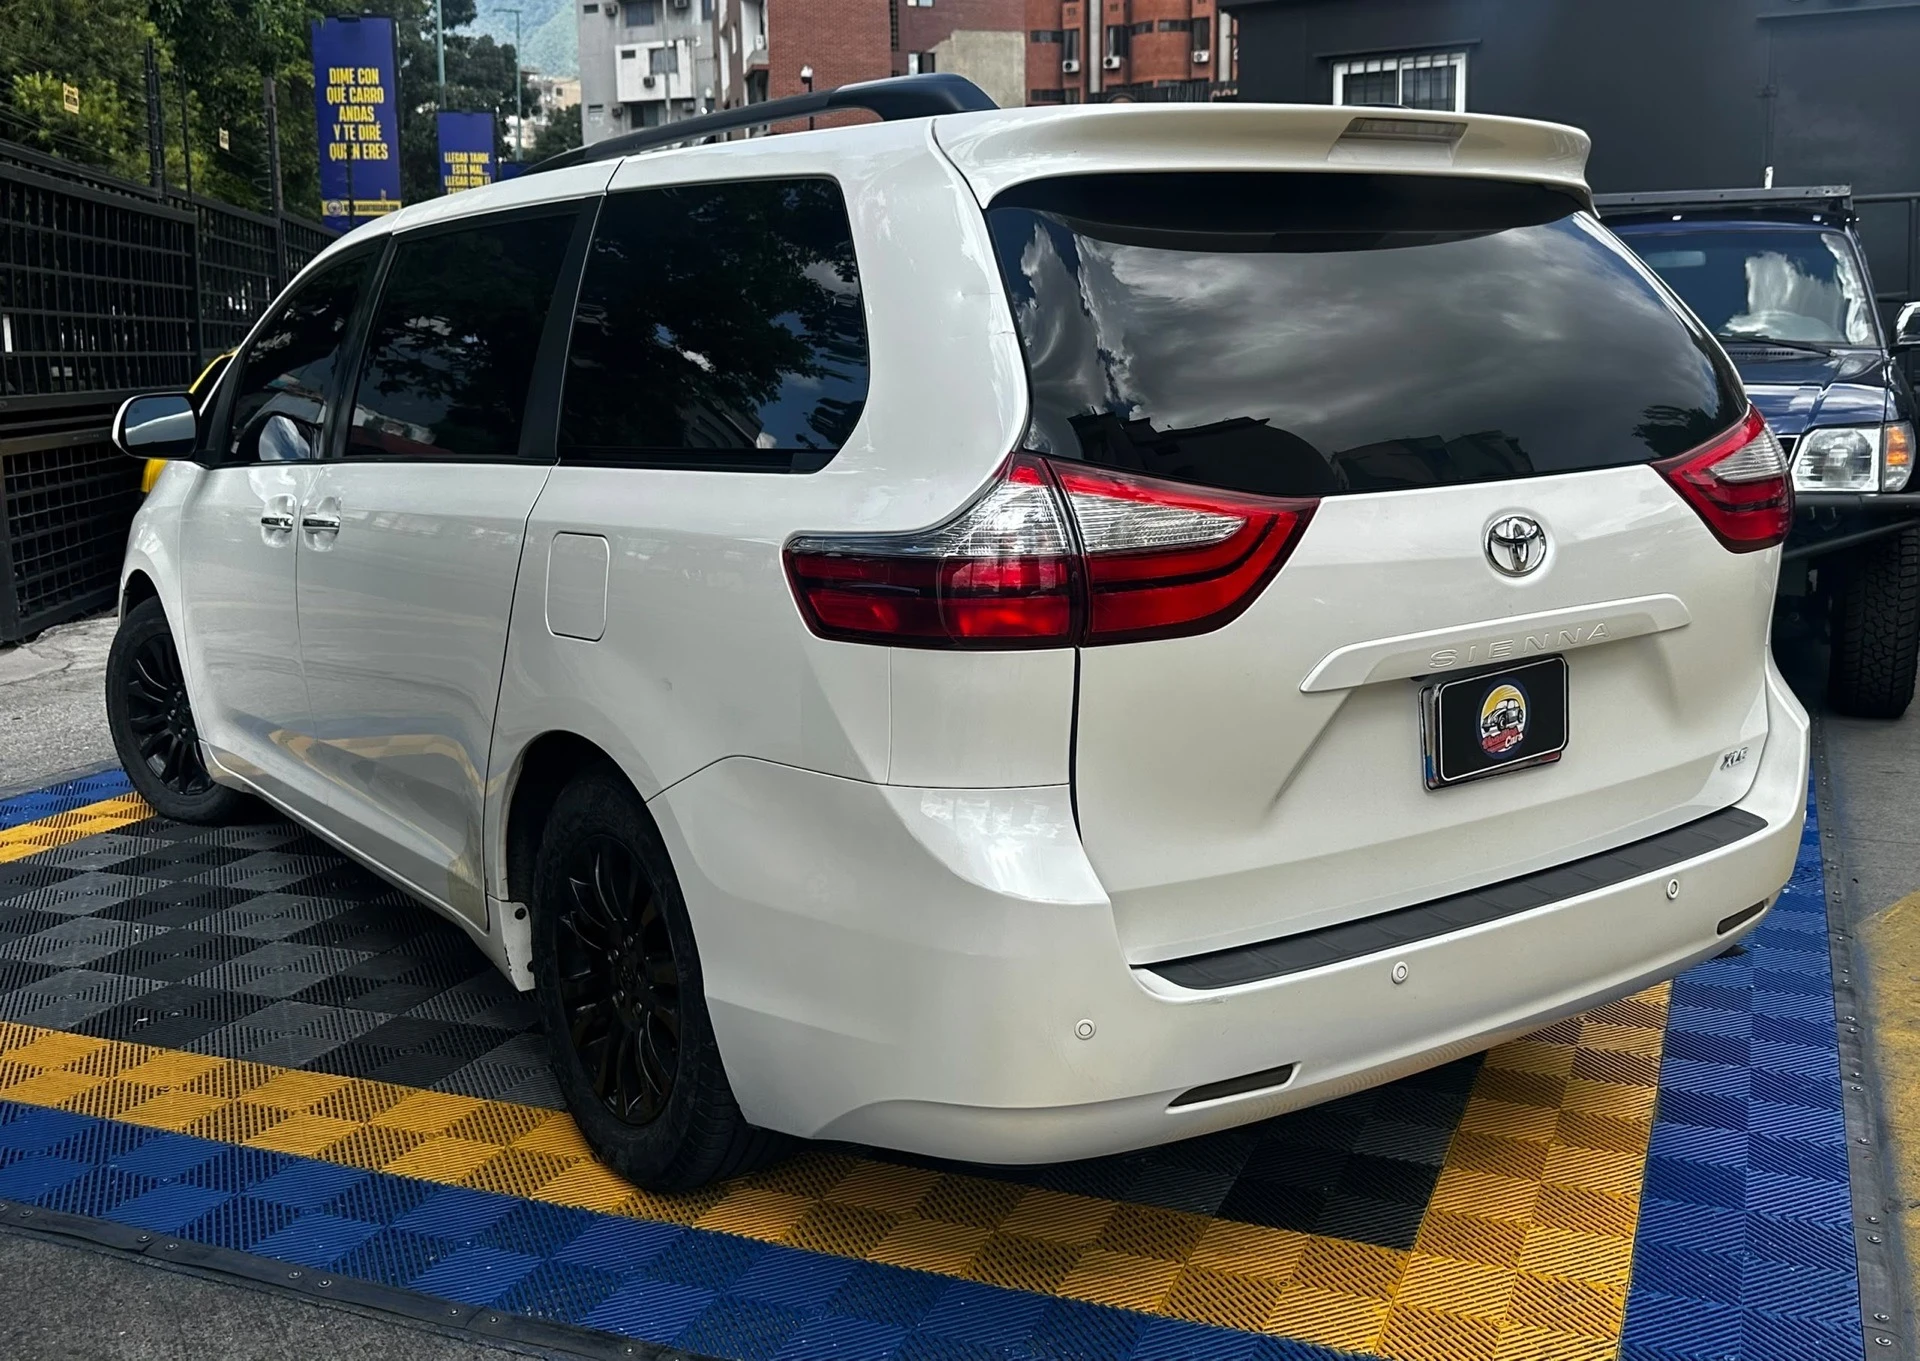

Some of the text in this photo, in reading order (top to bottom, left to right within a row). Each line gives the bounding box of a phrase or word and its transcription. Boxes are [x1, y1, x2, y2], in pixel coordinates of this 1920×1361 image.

[329, 67, 380, 85] DIME CON
[326, 83, 385, 106] QUÉ CARRO
[339, 105, 375, 123] ANDAS
[333, 120, 382, 141] Y TE DIRÉ
[362, 142, 389, 160] ERES
[1428, 621, 1612, 669] SIENNA
[1504, 732, 1524, 748] Cars
[1719, 746, 1749, 771] XLE
